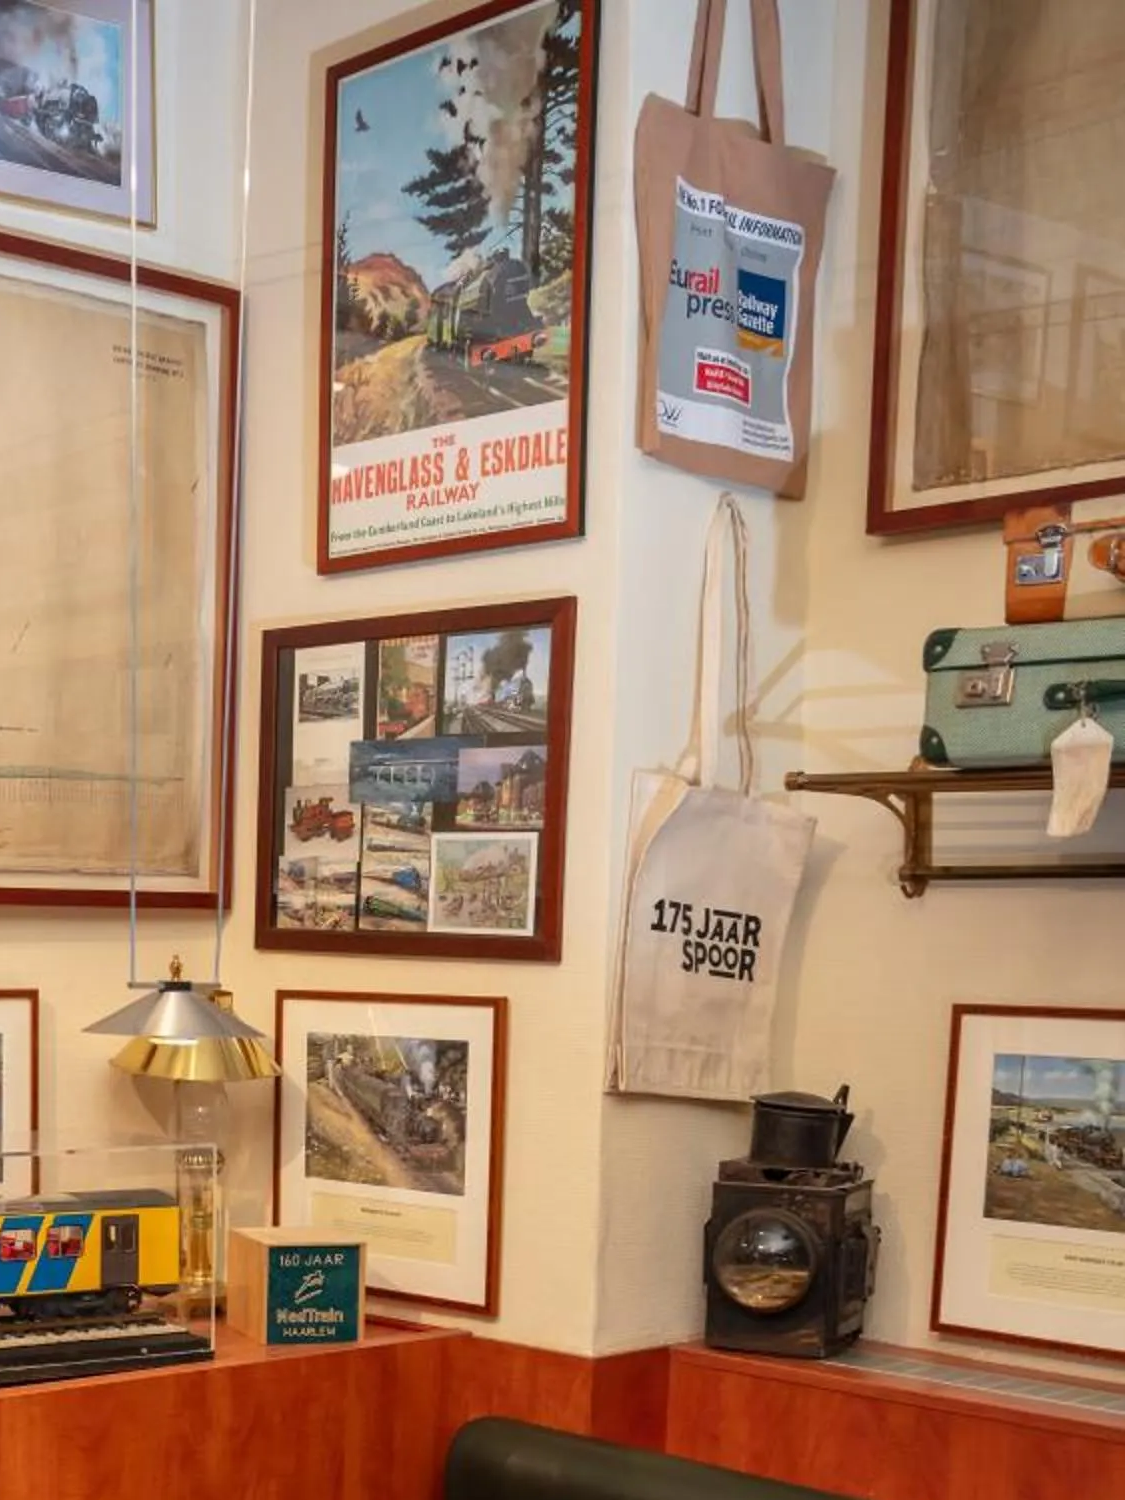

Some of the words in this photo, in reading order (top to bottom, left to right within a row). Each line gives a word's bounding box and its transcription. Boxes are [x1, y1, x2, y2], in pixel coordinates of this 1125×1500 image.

[431, 434, 457, 449] THE
[455, 447, 471, 481] &
[480, 427, 567, 478] ESKDALE
[406, 481, 481, 512] RAILWAY
[650, 898, 693, 937] 175
[696, 907, 762, 948] JAAR
[681, 939, 756, 983] SPOOR
[279, 1253, 300, 1267] 160
[304, 1252, 344, 1266] JAAR
[276, 1306, 344, 1325] NedTrain
[282, 1325, 336, 1338] HAARLEM
